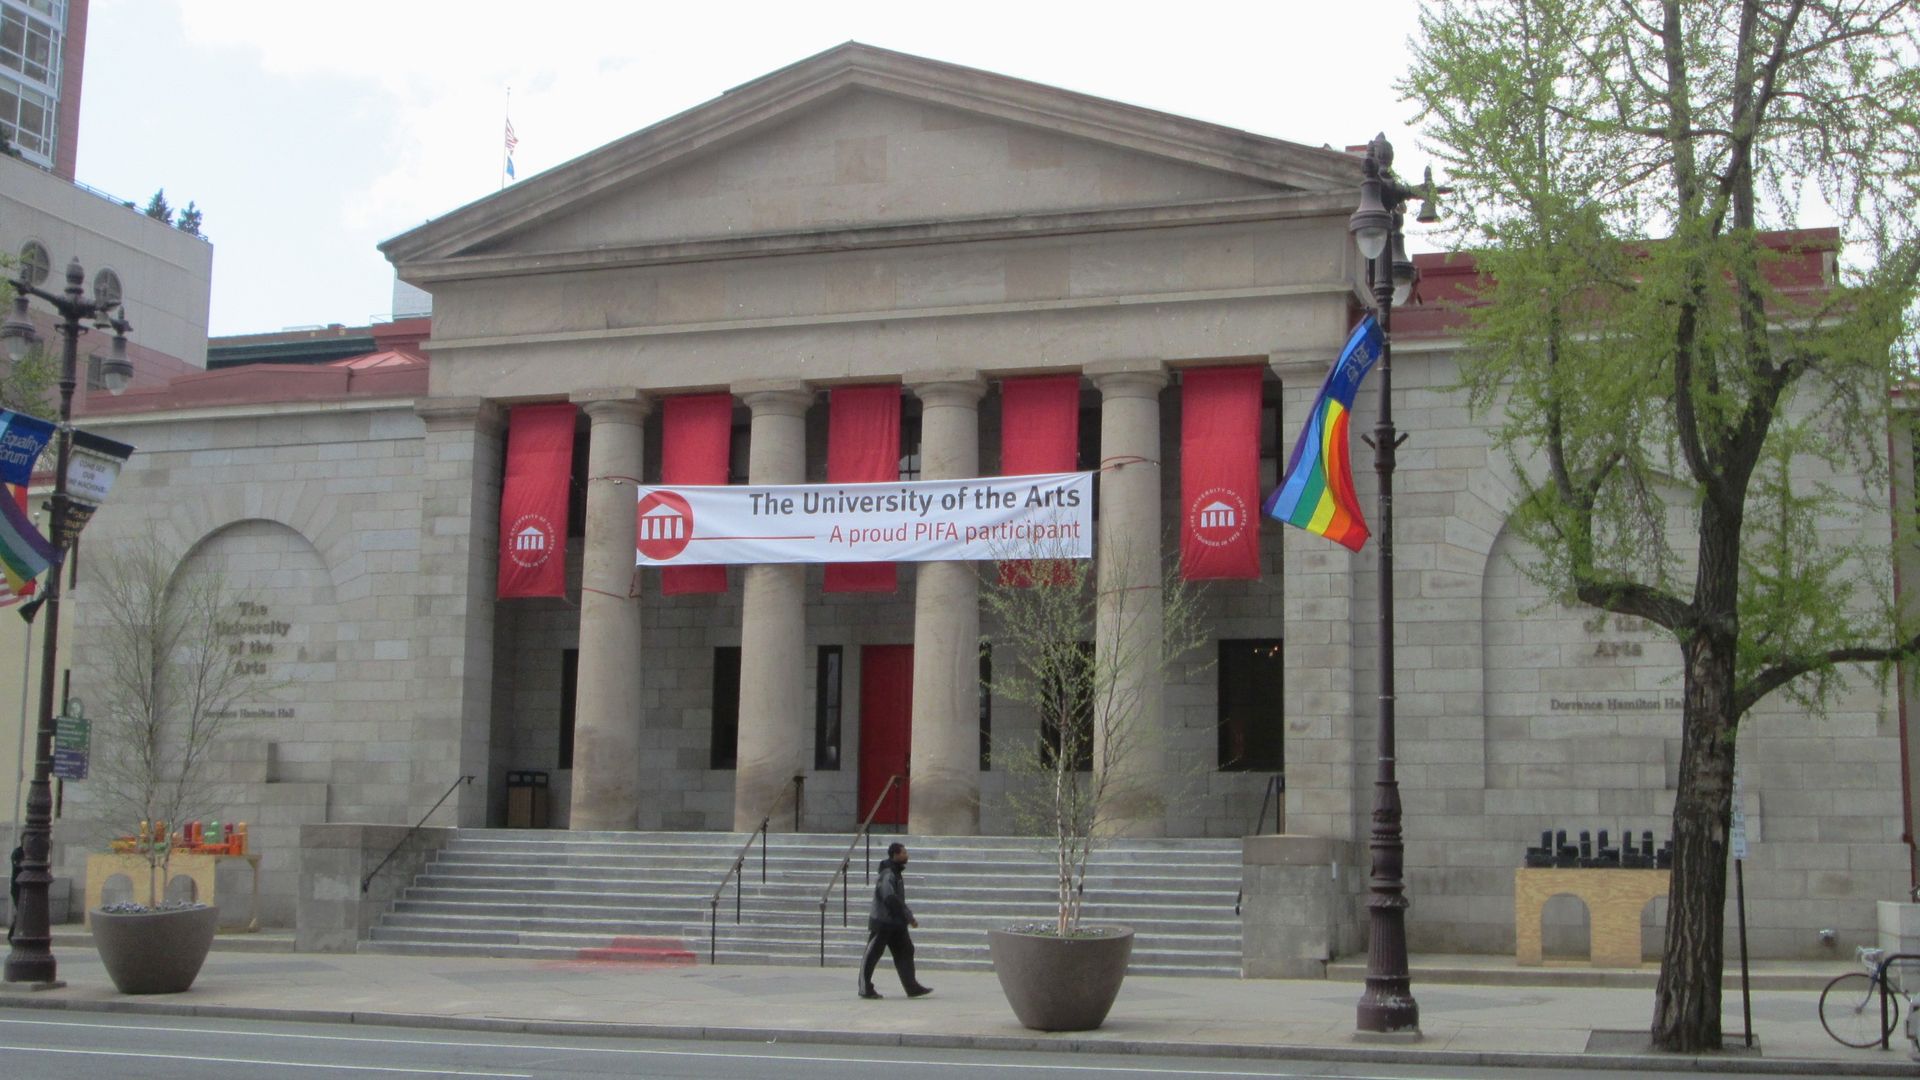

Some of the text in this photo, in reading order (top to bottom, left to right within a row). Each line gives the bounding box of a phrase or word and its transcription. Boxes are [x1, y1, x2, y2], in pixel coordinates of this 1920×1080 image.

[3, 430, 43, 455] Equality
[749, 484, 1081, 517] The University of the Arts
[829, 519, 1081, 548] A proud PIFA participant
[238, 601, 268, 617] The
[1594, 641, 1643, 657] Arts
[234, 660, 267, 676] Arts
[1550, 698, 1685, 712] Dorrance Hamilton Hal
